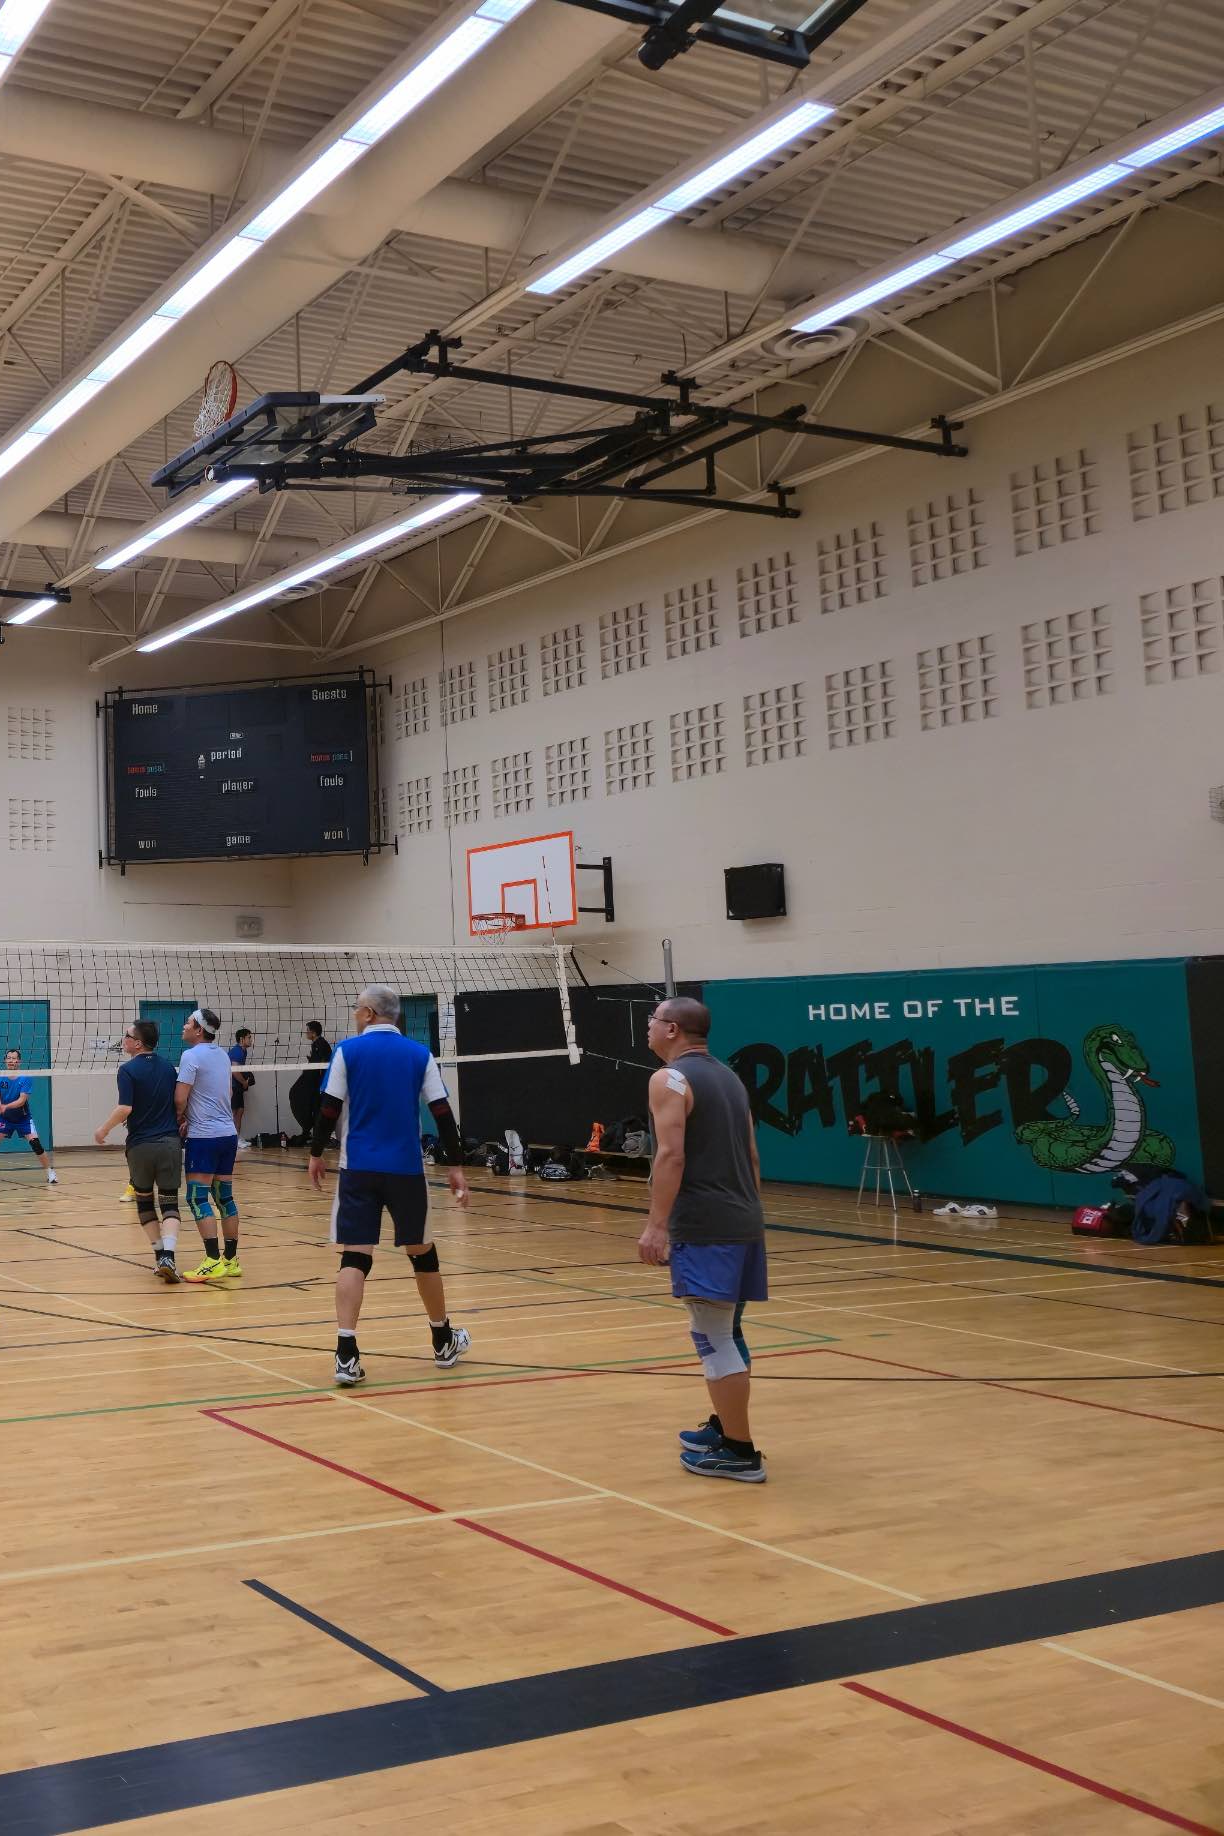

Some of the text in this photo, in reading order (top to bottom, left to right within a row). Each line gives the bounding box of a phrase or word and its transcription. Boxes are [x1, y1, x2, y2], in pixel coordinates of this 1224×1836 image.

[132, 703, 158, 715] Home
[210, 748, 242, 761] period
[222, 780, 254, 793] player
[320, 775, 344, 786] fouls
[135, 787, 157, 798] fouls
[226, 835, 251, 847] game
[324, 830, 343, 840] won
[138, 840, 156, 849] won
[808, 996, 1020, 1020] HOME OF THE
